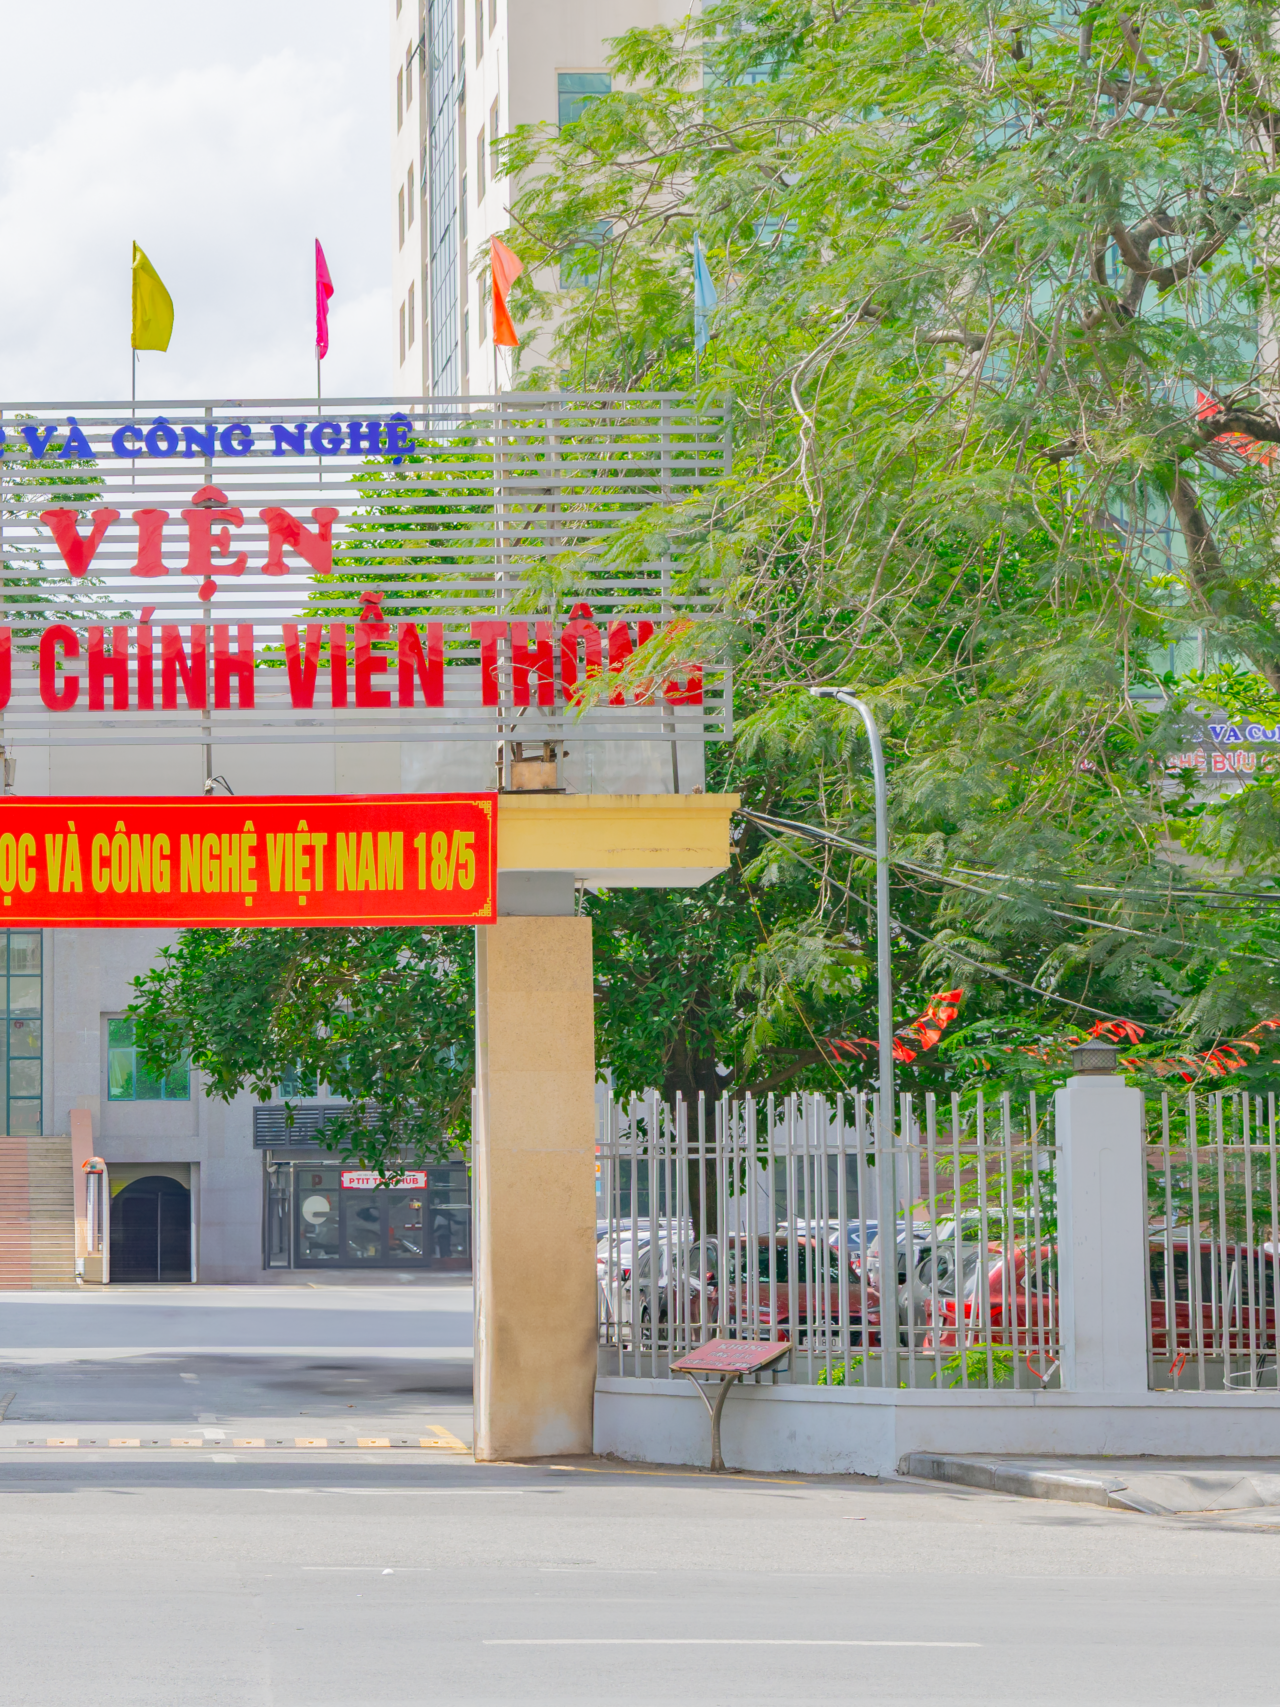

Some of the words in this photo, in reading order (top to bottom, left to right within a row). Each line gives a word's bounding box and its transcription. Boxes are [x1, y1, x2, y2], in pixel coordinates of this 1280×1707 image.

[22, 417, 95, 459] VÀ
[112, 416, 254, 459] CÔNG
[271, 412, 415, 465] NGHỆ
[40, 485, 339, 602] VIỆN
[39, 605, 255, 711] CHÍNH
[282, 590, 444, 708] VIỄN
[44, 820, 83, 893] VÀ
[91, 820, 171, 894] CÔNG
[180, 820, 258, 907] NGHỆ
[266, 819, 328, 906] VIỆT
[336, 831, 404, 892] NAM
[413, 829, 476, 891] 18/5
[349, 1177, 371, 1185] PTIT
[717, 1343, 770, 1352] KHÔNG
